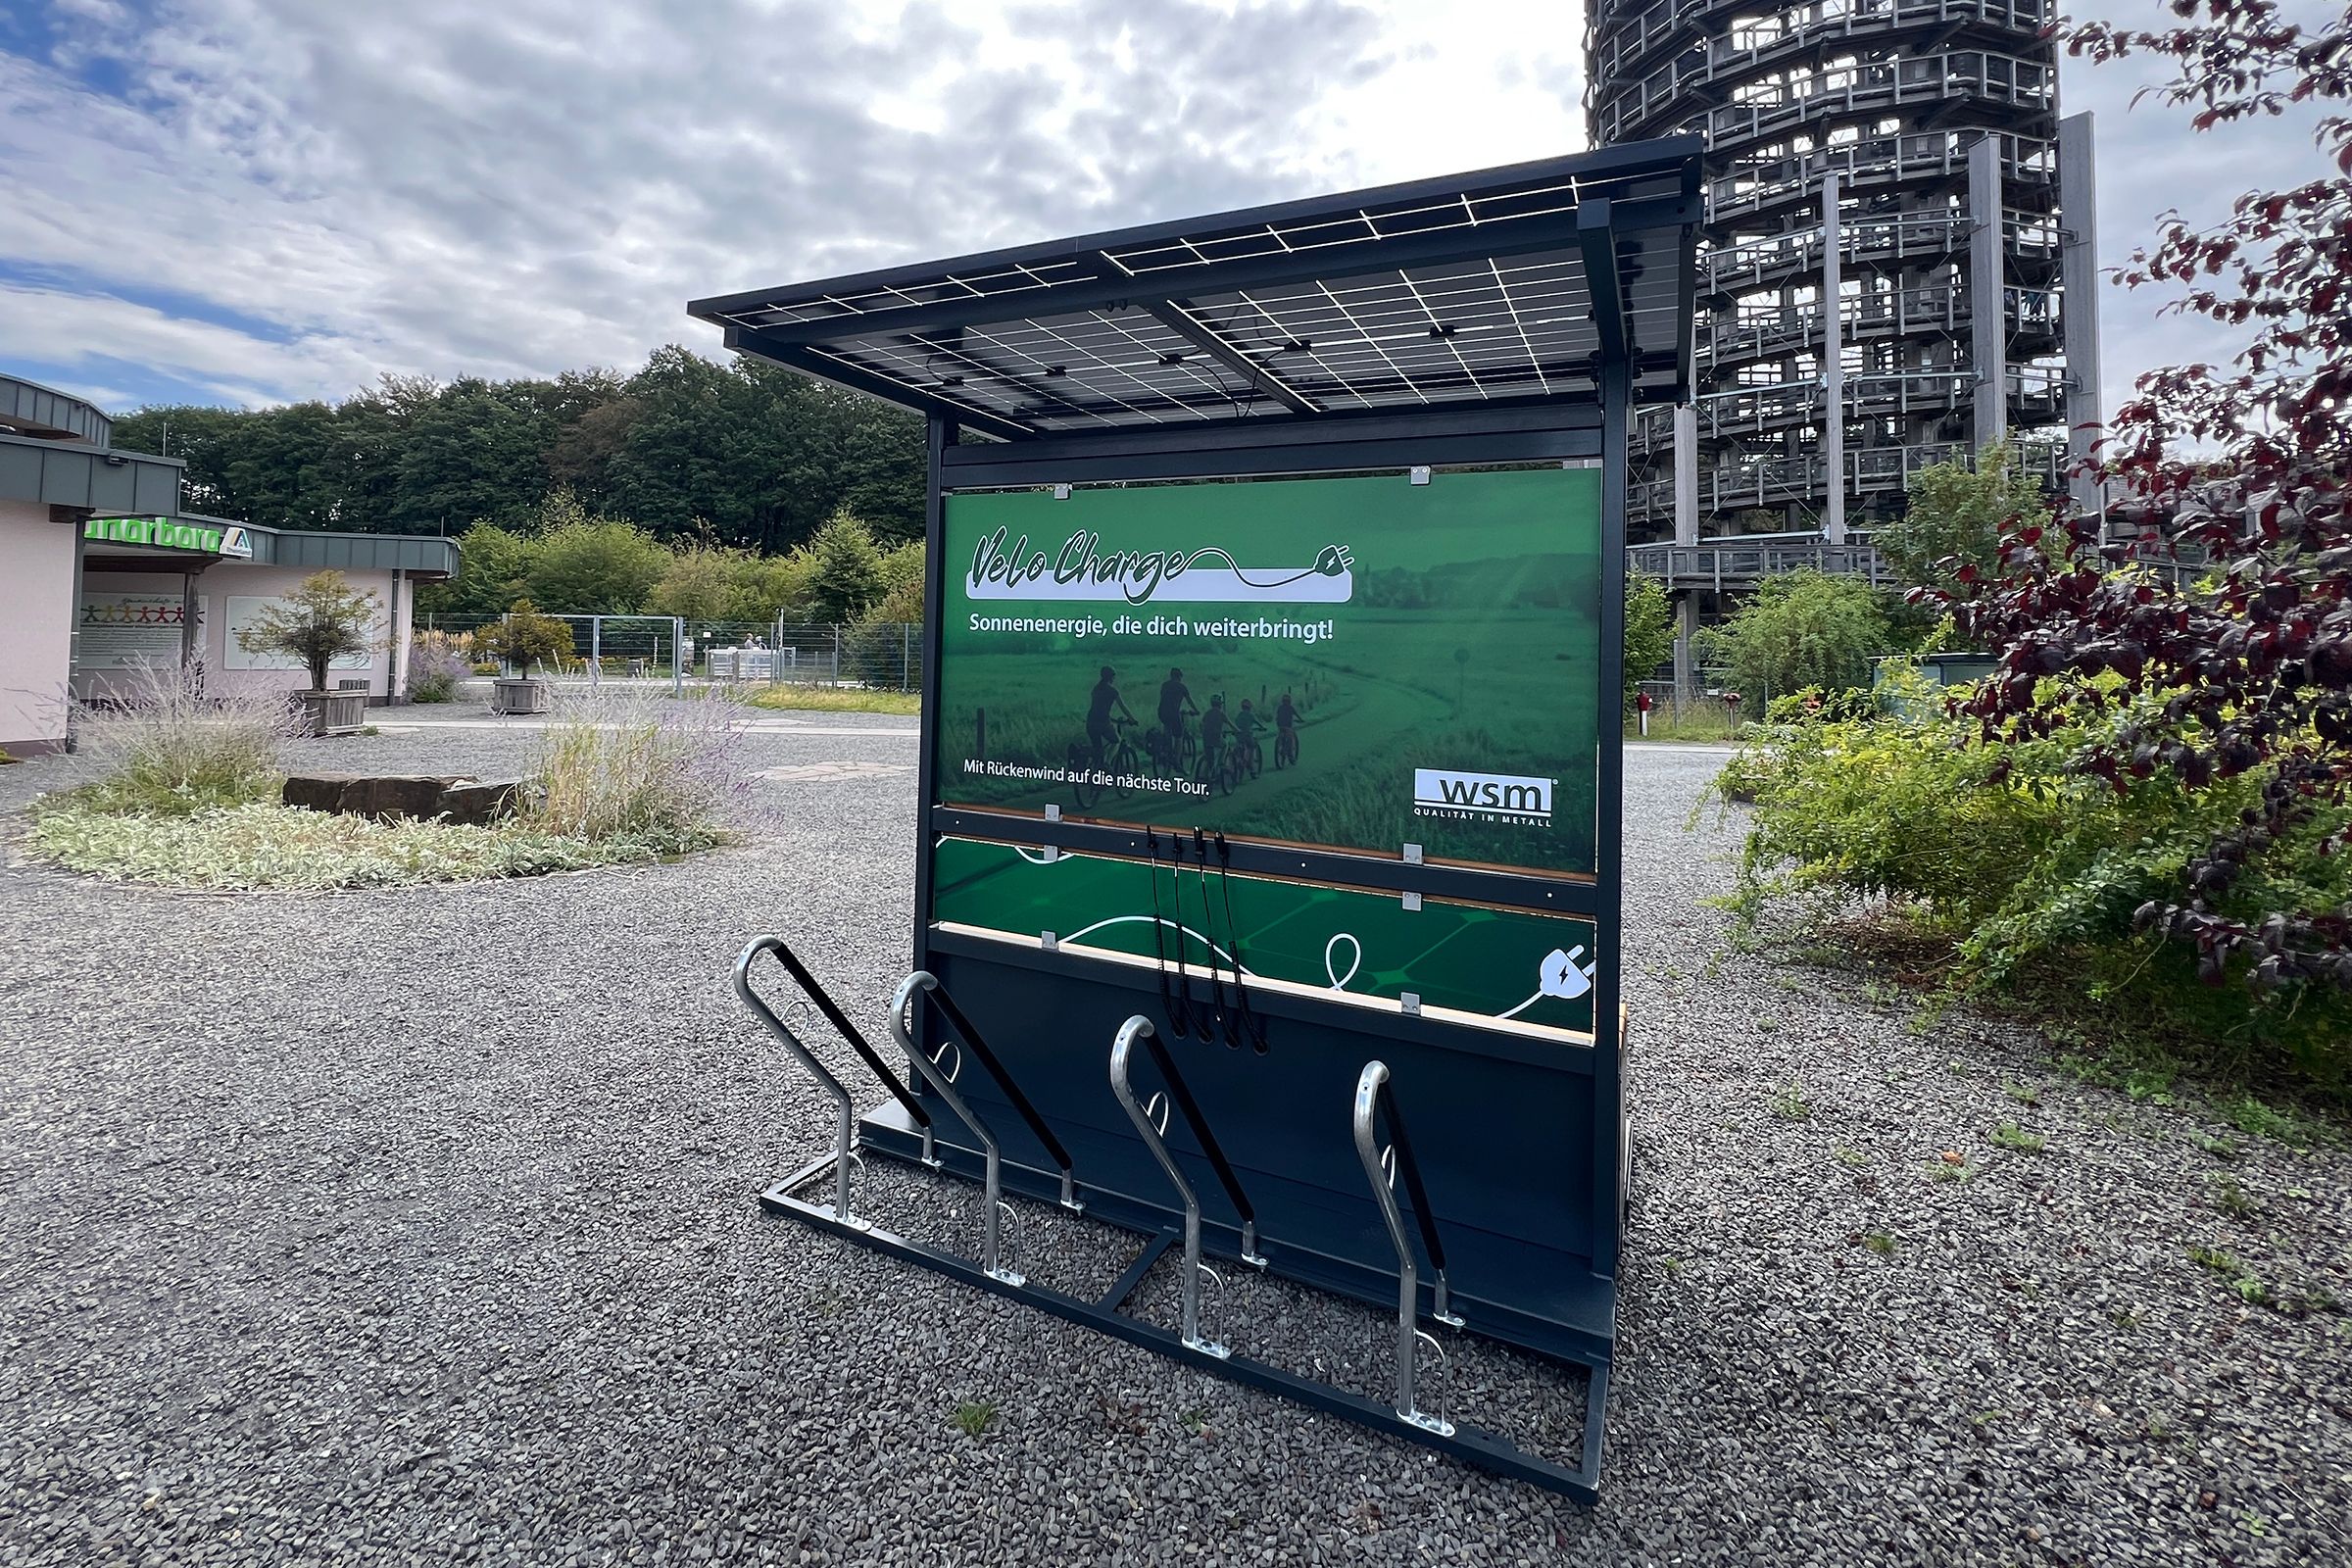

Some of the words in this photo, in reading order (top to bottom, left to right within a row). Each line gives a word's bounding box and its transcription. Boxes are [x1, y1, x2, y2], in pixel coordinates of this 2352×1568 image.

[972, 525, 1048, 589] Velo
[1053, 529, 1188, 607] Charge
[969, 612, 1108, 638] Sonnenenergie,
[1111, 614, 1142, 635] die
[1146, 615, 1189, 636] dich
[1193, 616, 1334, 645] weiterbringt!
[963, 758, 985, 774] Mit
[987, 760, 1065, 782] Rückenwind
[1066, 768, 1092, 785] auf
[1092, 769, 1113, 787] die
[1116, 773, 1172, 792] nächste
[1173, 777, 1210, 797] Tour.
[1439, 779, 1542, 811] wsm
[1413, 807, 1475, 820] QUALITÄT
[1481, 813, 1494, 822] IN
[1501, 815, 1551, 828] METALL
